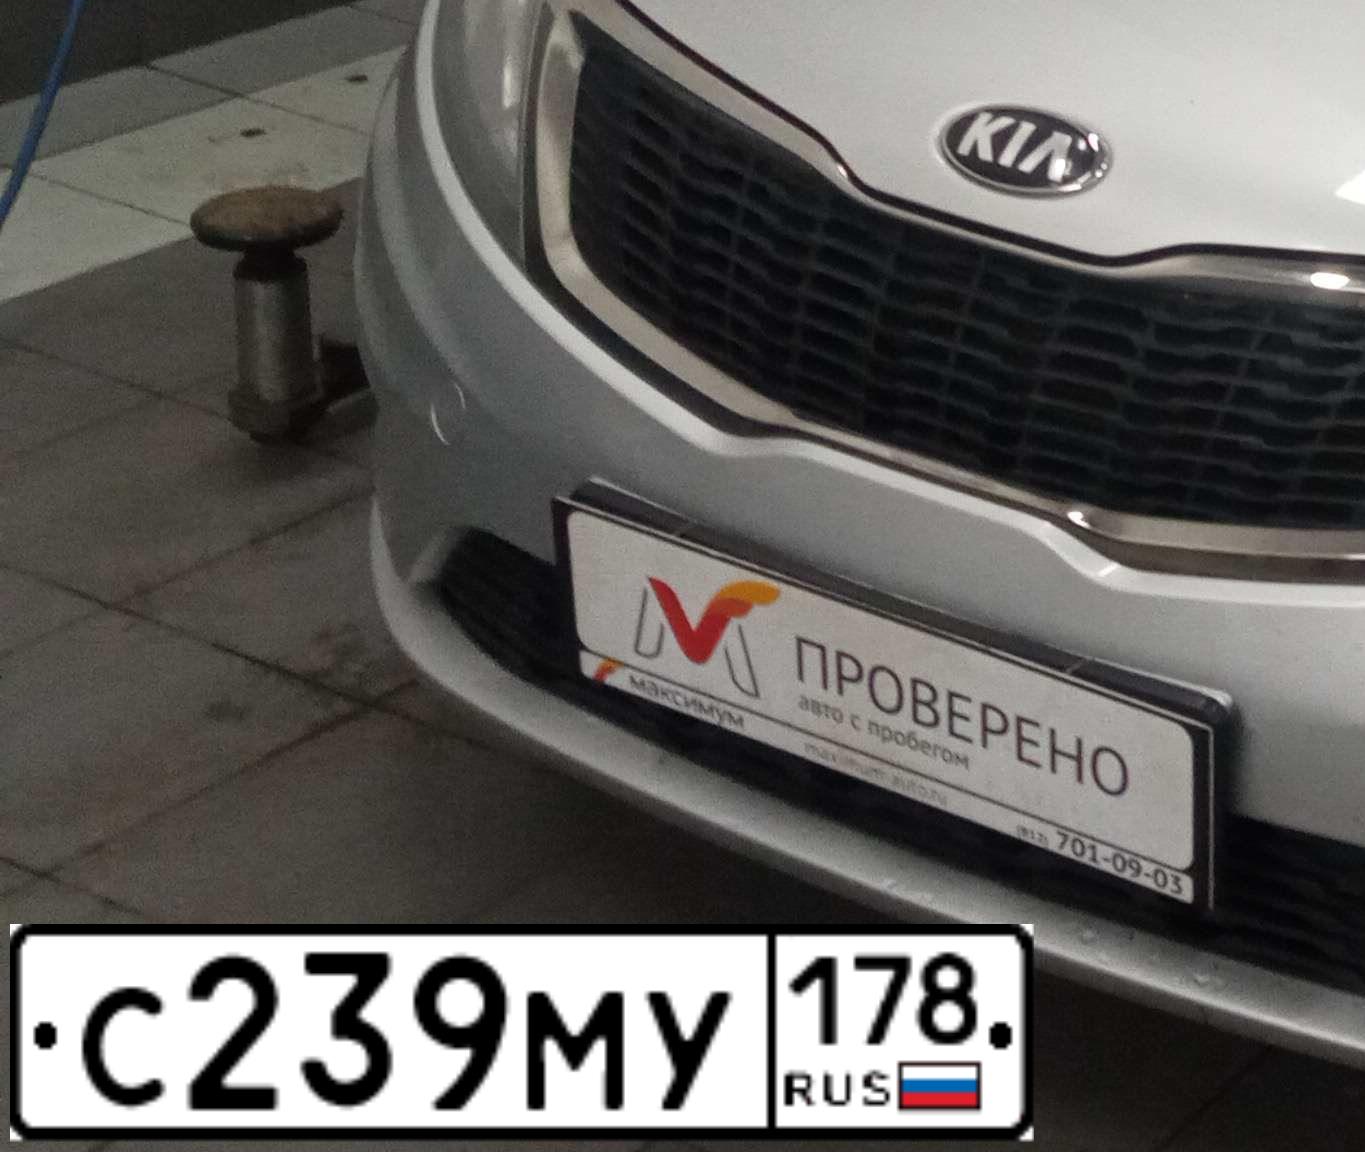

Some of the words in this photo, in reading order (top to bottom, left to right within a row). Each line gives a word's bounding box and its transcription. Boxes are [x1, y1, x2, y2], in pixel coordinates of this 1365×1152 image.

[957, 112, 1073, 183] KIA
[795, 635, 1130, 796] ПРОВЕРЕНО
[798, 695, 845, 725] авто
[867, 719, 971, 770] пробегом
[1055, 829, 1183, 896] 701-09-03
